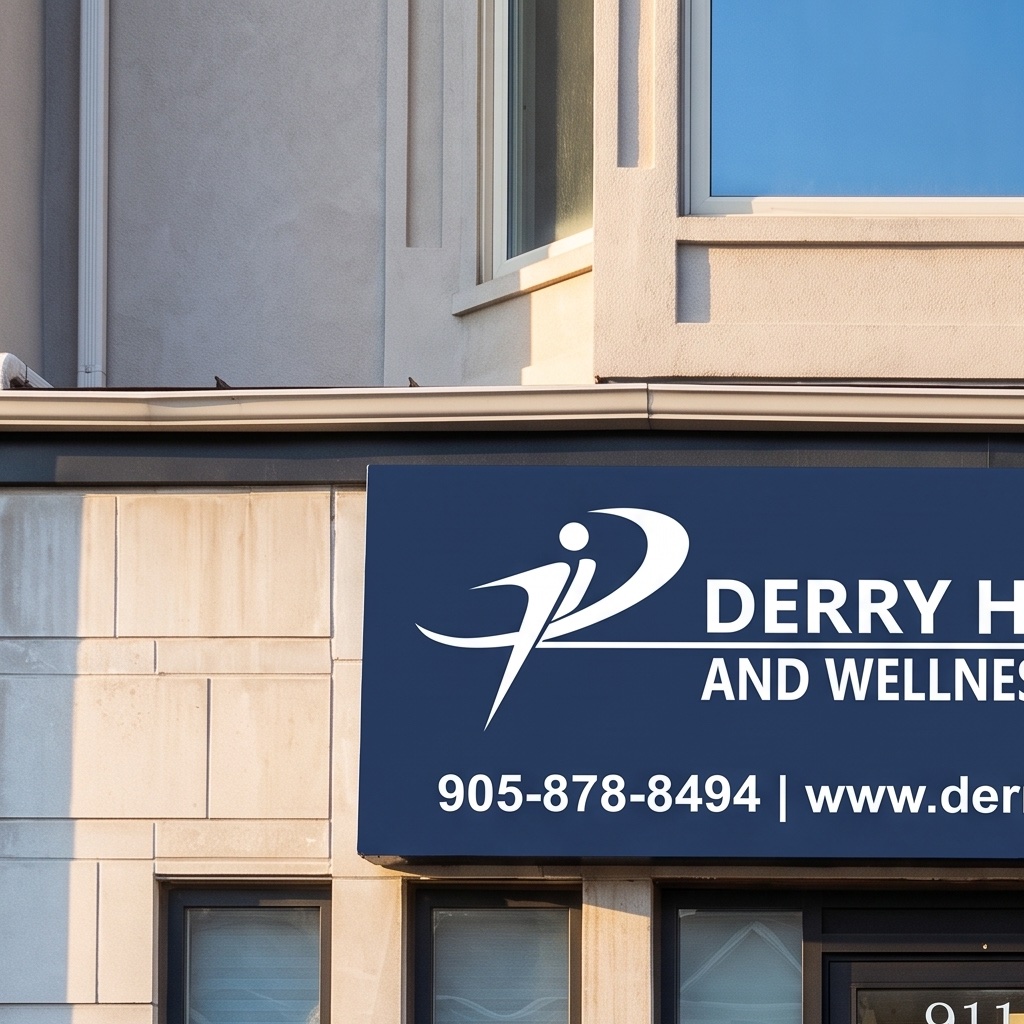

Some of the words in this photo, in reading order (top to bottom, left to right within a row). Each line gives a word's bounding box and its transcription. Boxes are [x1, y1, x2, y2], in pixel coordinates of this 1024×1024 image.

[706, 579, 952, 634] DERRY
[700, 657, 809, 701] AND
[438, 773, 761, 813] 905-878-8494
